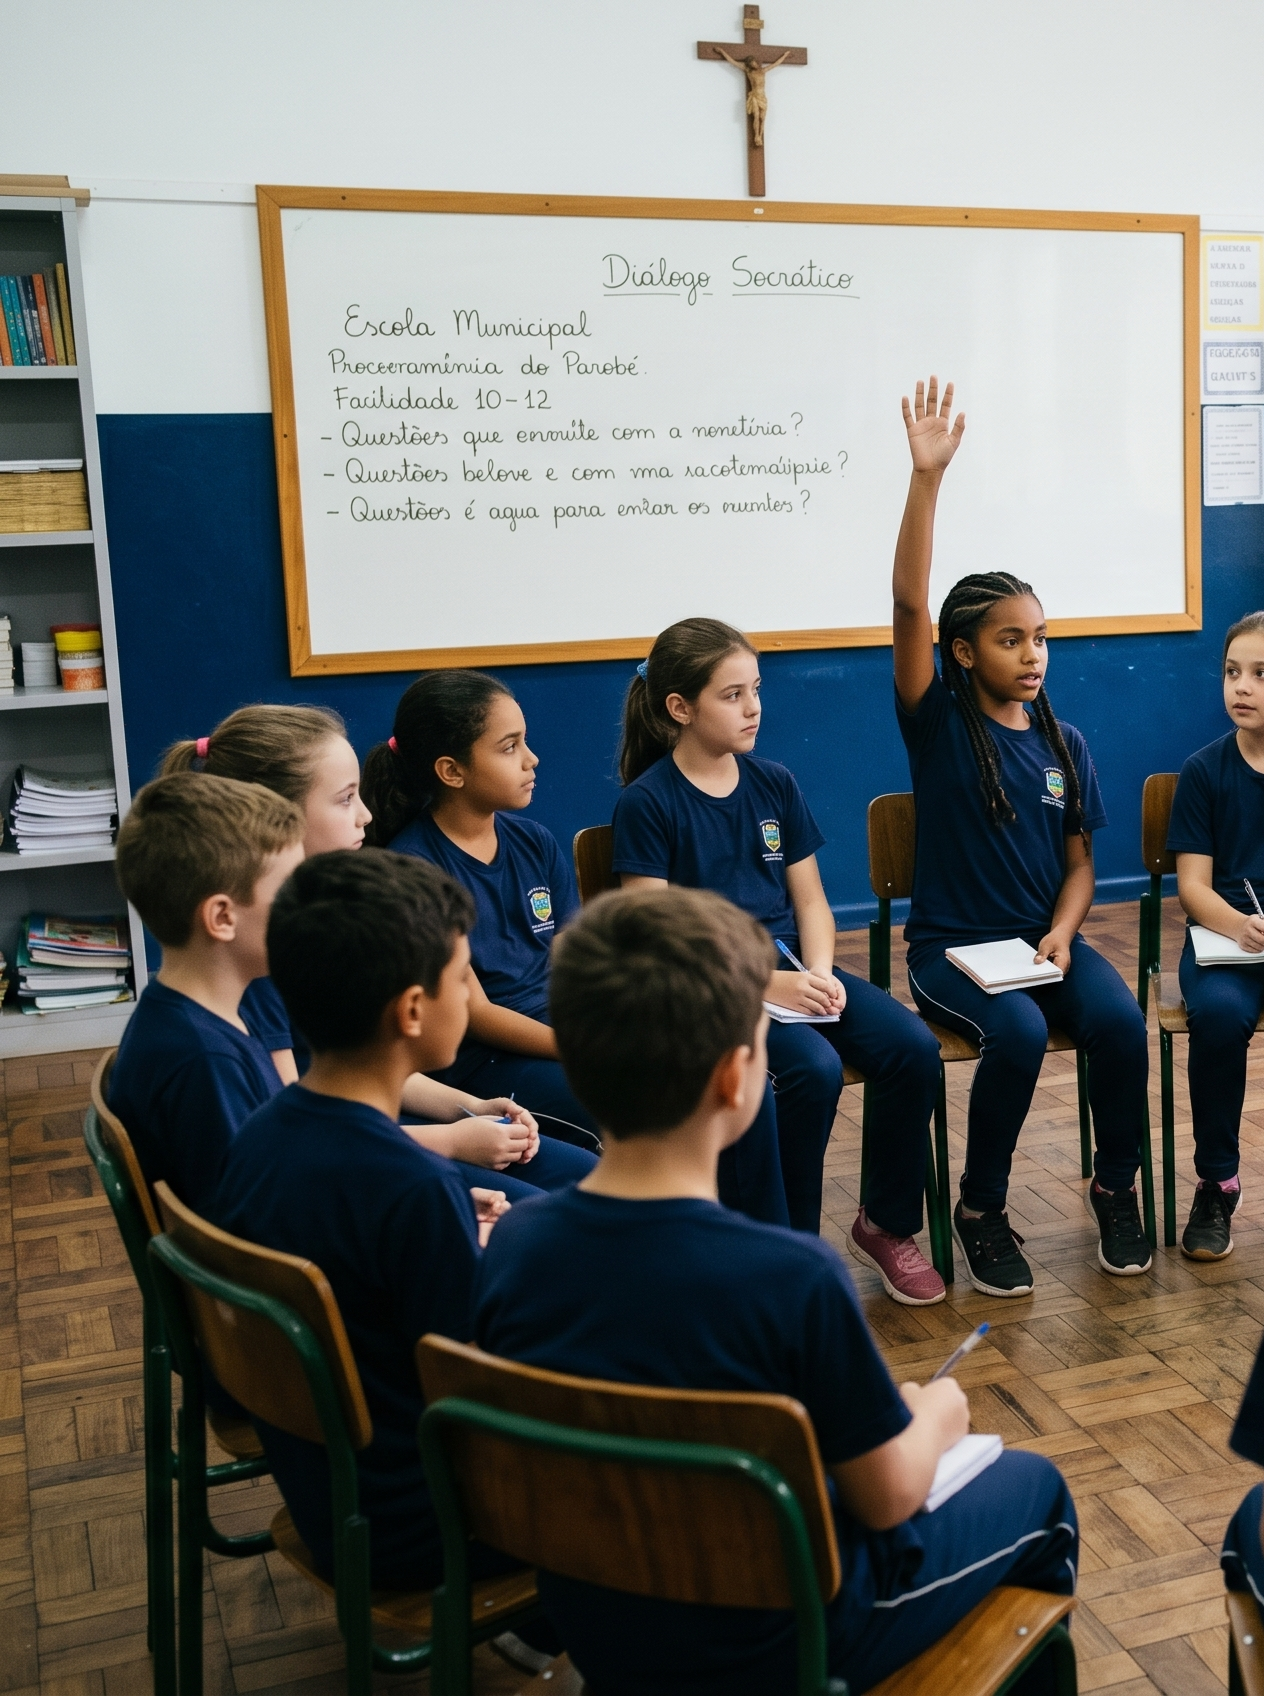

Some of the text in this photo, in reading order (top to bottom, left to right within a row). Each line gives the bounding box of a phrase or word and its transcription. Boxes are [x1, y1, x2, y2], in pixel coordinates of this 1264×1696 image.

[602, 254, 854, 306] Diálogo Socrático
[344, 303, 593, 351] Escola Municipal
[332, 385, 459, 411] Facilidade
[341, 420, 449, 448] Questões
[462, 430, 504, 458] que
[612, 427, 656, 441] com
[668, 426, 683, 439] a
[345, 457, 449, 484] Questões
[545, 467, 559, 482] e
[571, 467, 616, 482] com
[464, 498, 476, 521] é
[488, 506, 540, 533] agua
[553, 505, 606, 530] para
